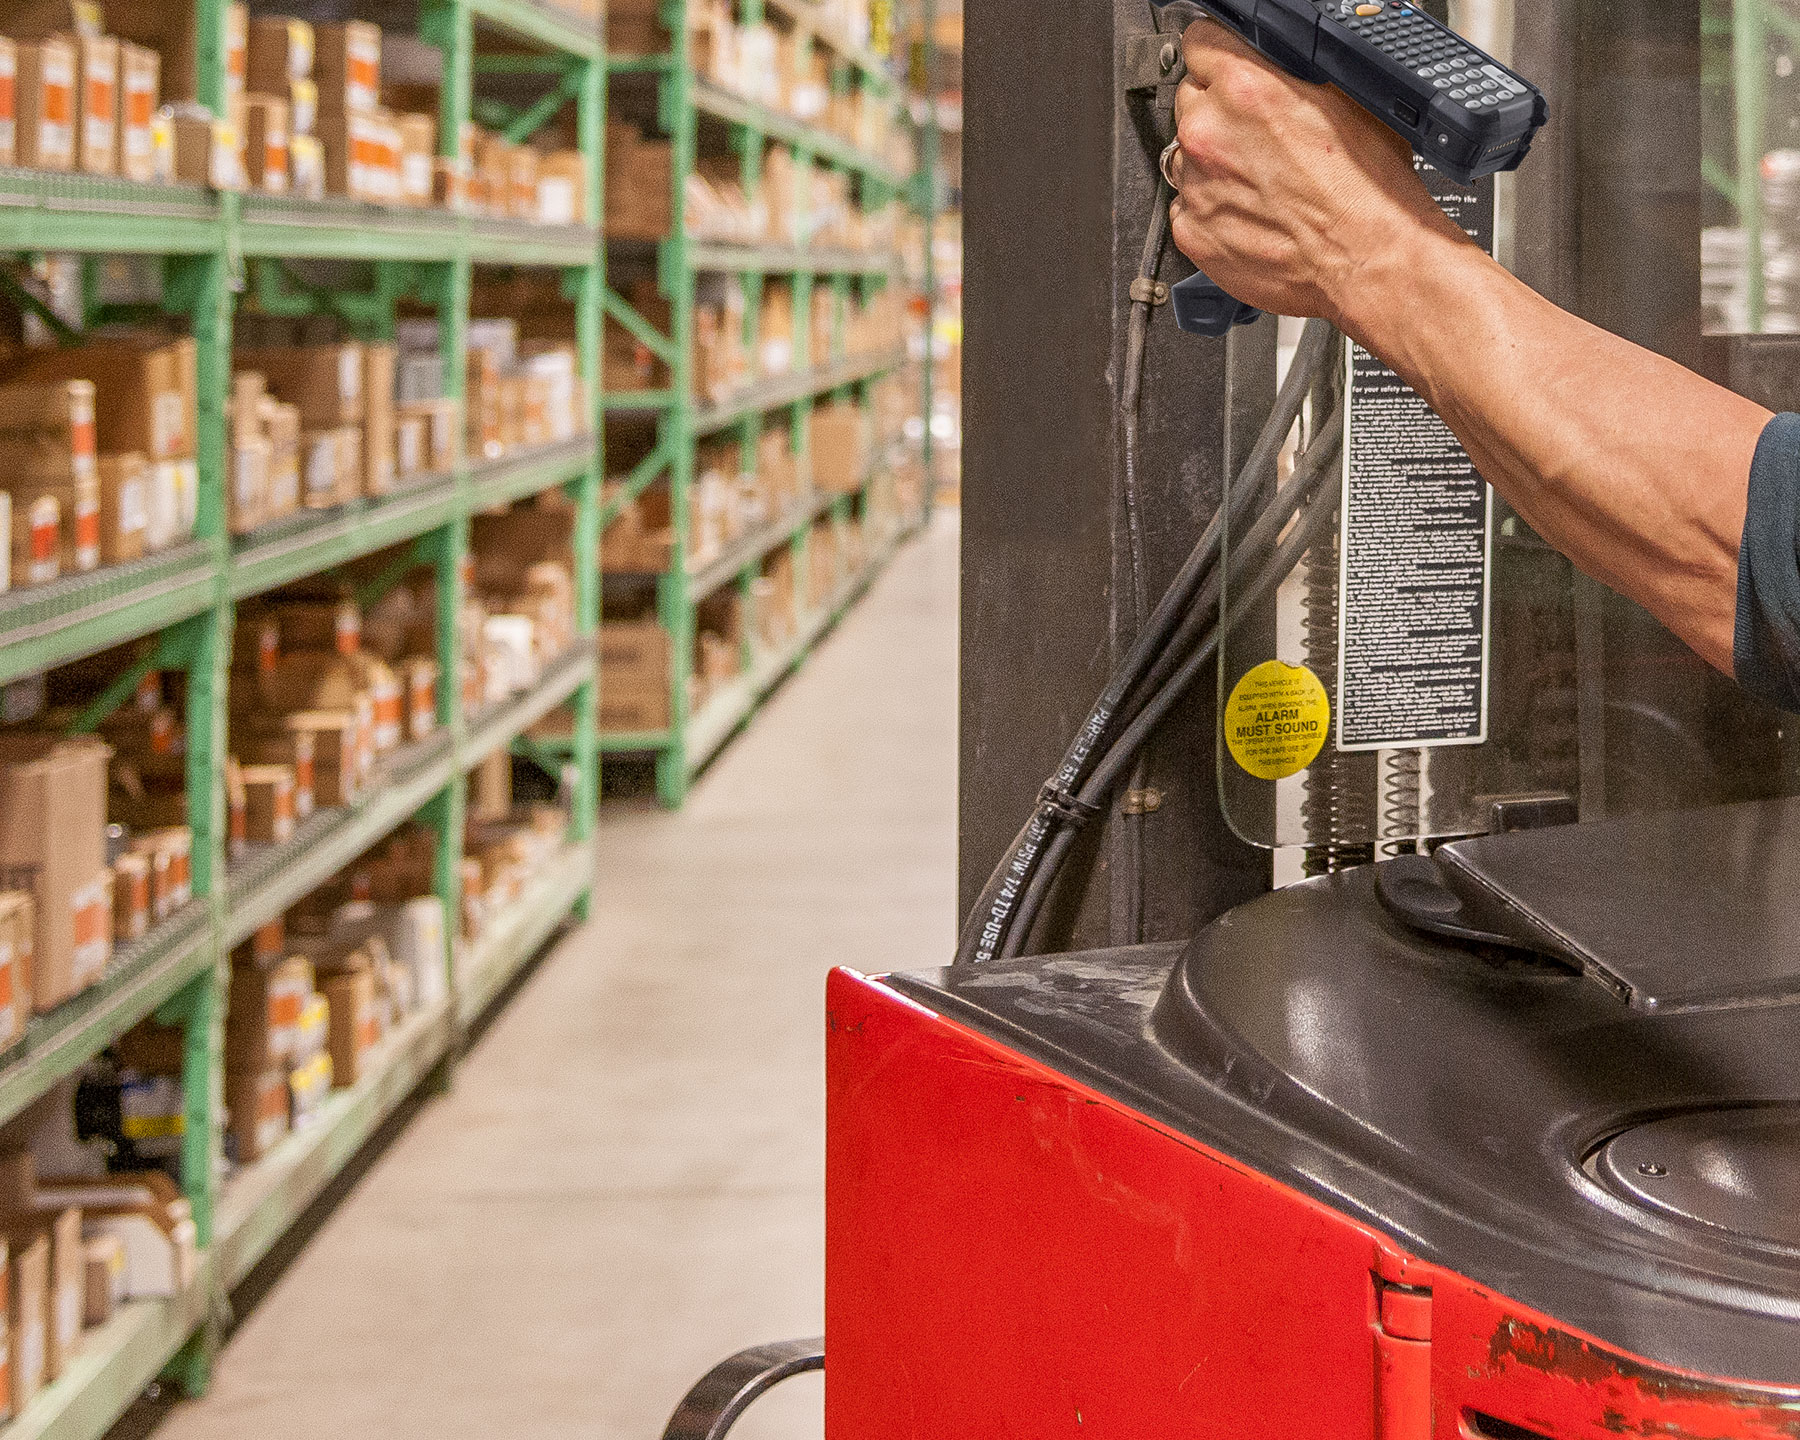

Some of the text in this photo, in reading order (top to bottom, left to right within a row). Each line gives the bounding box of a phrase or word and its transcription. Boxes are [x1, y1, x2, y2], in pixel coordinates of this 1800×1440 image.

[1443, 194, 1461, 203] safety
[1464, 195, 1477, 203] the
[1364, 386, 1379, 394] your
[1381, 385, 1400, 394] safety
[1255, 709, 1298, 723] ALARM
[1236, 720, 1318, 738] MUST SOUND
